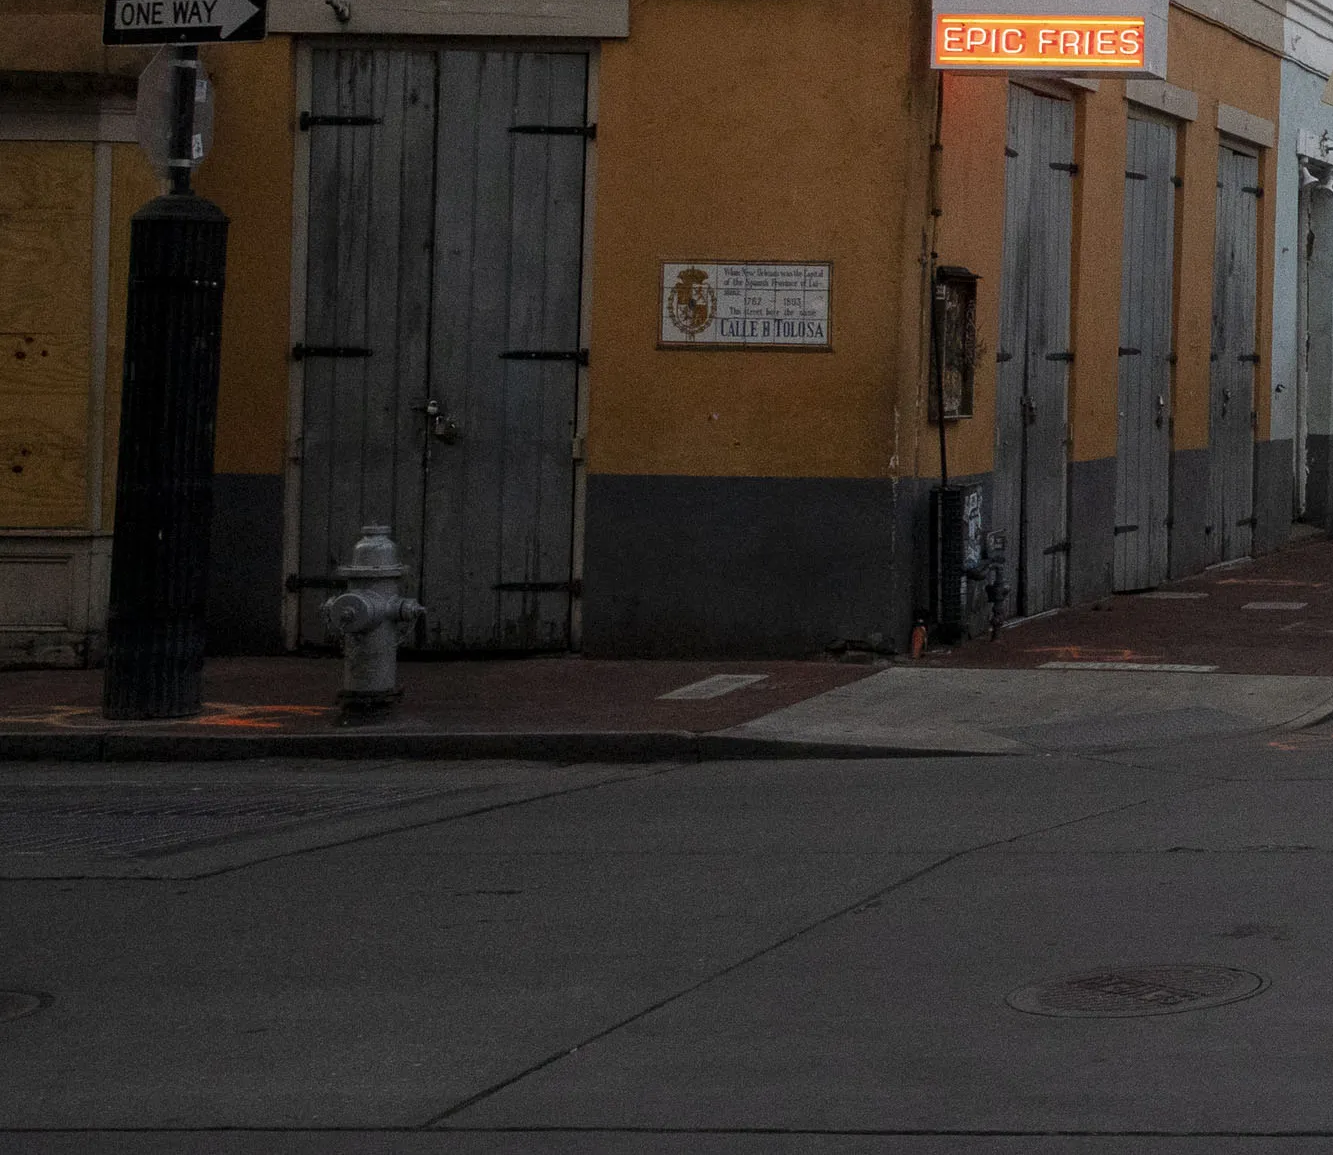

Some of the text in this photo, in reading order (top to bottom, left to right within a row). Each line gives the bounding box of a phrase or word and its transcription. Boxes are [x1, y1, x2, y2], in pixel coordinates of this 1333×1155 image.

[121, 0, 218, 26] ONE WAY
[944, 26, 1141, 56] EPIC FRIES
[720, 319, 758, 337] CALLE
[775, 319, 824, 338] TOLOSA
